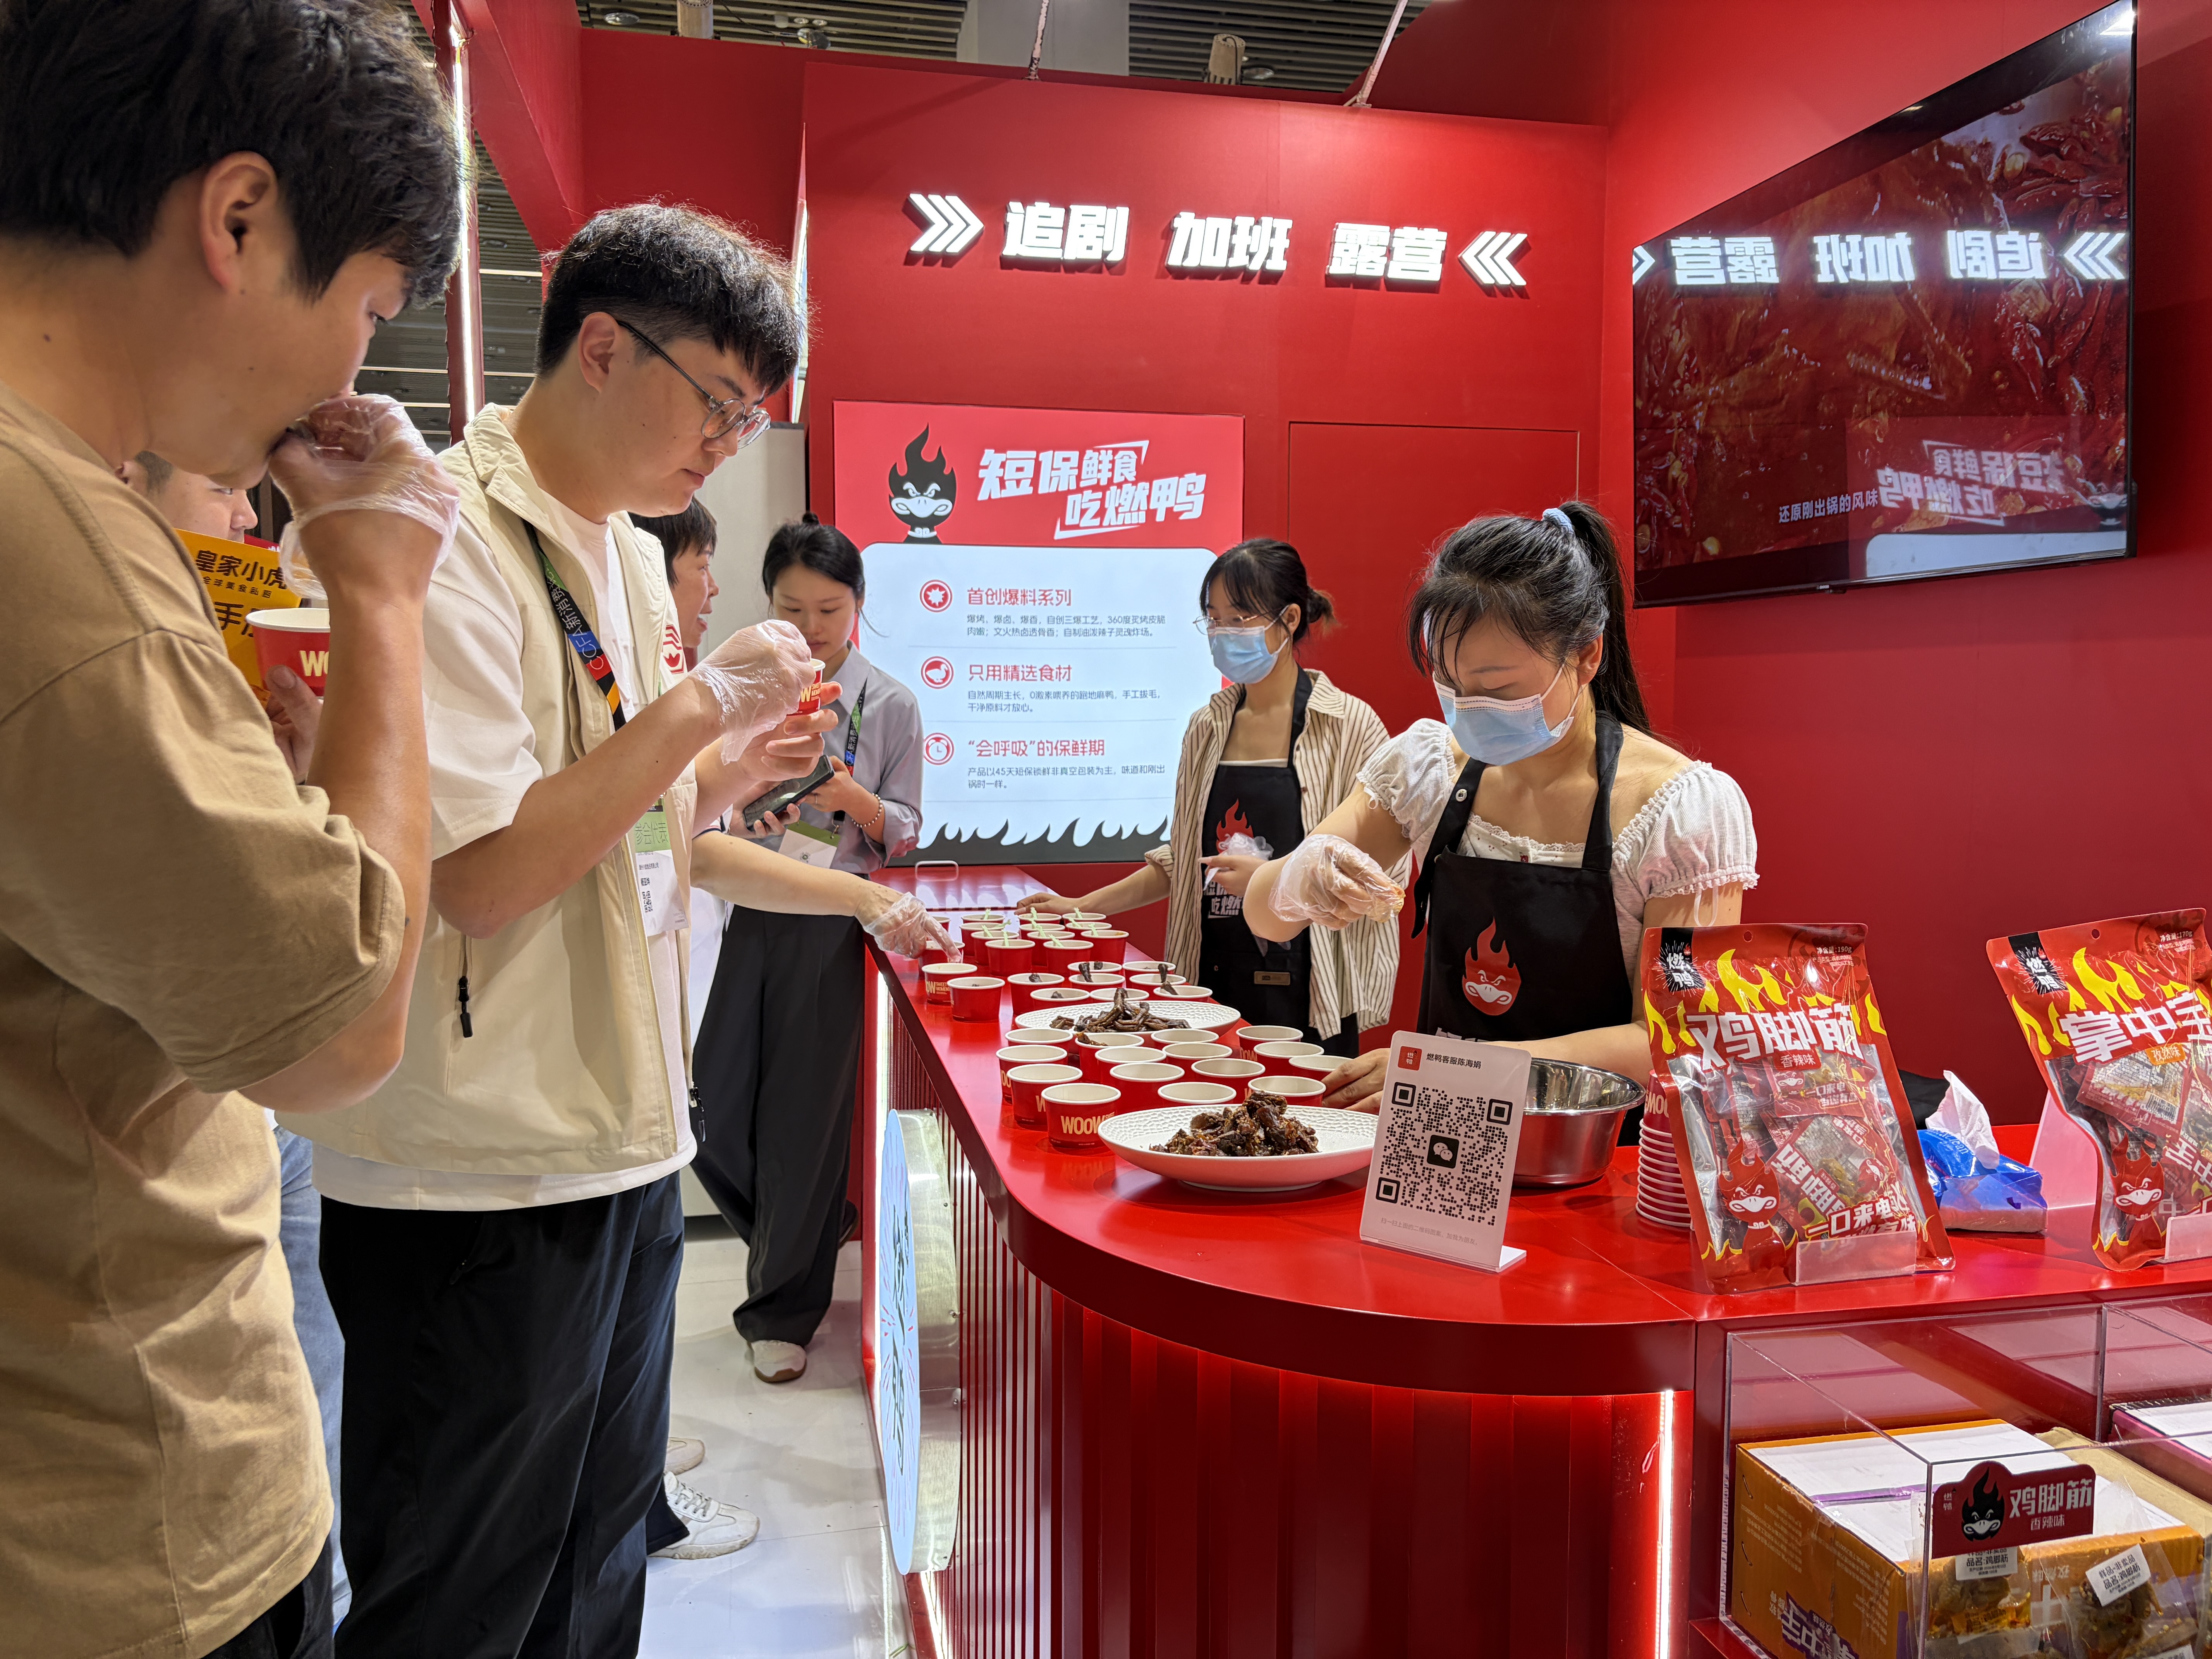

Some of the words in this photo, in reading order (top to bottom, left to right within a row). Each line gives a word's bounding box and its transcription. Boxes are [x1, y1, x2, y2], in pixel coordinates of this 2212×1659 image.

[1004, 202, 1130, 264] 追剧
[1168, 212, 1293, 272] 加班
[1329, 222, 1448, 284] 露营
[977, 448, 1138, 501] 短保鲜食
[1778, 488, 1878, 524] 还原刚出锅的风味
[195, 550, 287, 590] 皇家小虎
[967, 588, 1072, 606] 首创爆料系列
[968, 665, 1072, 682] 只用精选食材
[968, 740, 1105, 757] “会呼吸”的保鲜期
[635, 821, 669, 845] 参会代表
[1211, 896, 1243, 915] 吃燃
[1686, 1001, 1865, 1071] 鸡脚筋
[2059, 991, 2212, 1063] 掌中宝
[1780, 1054, 1816, 1068] 香辣味
[2151, 1046, 2182, 1062] 孜然味
[1806, 1081, 1846, 1097] 一口来电
[2009, 1478, 2092, 1518] 鸡脚筋
[2030, 1515, 2065, 1531] 香辣味
